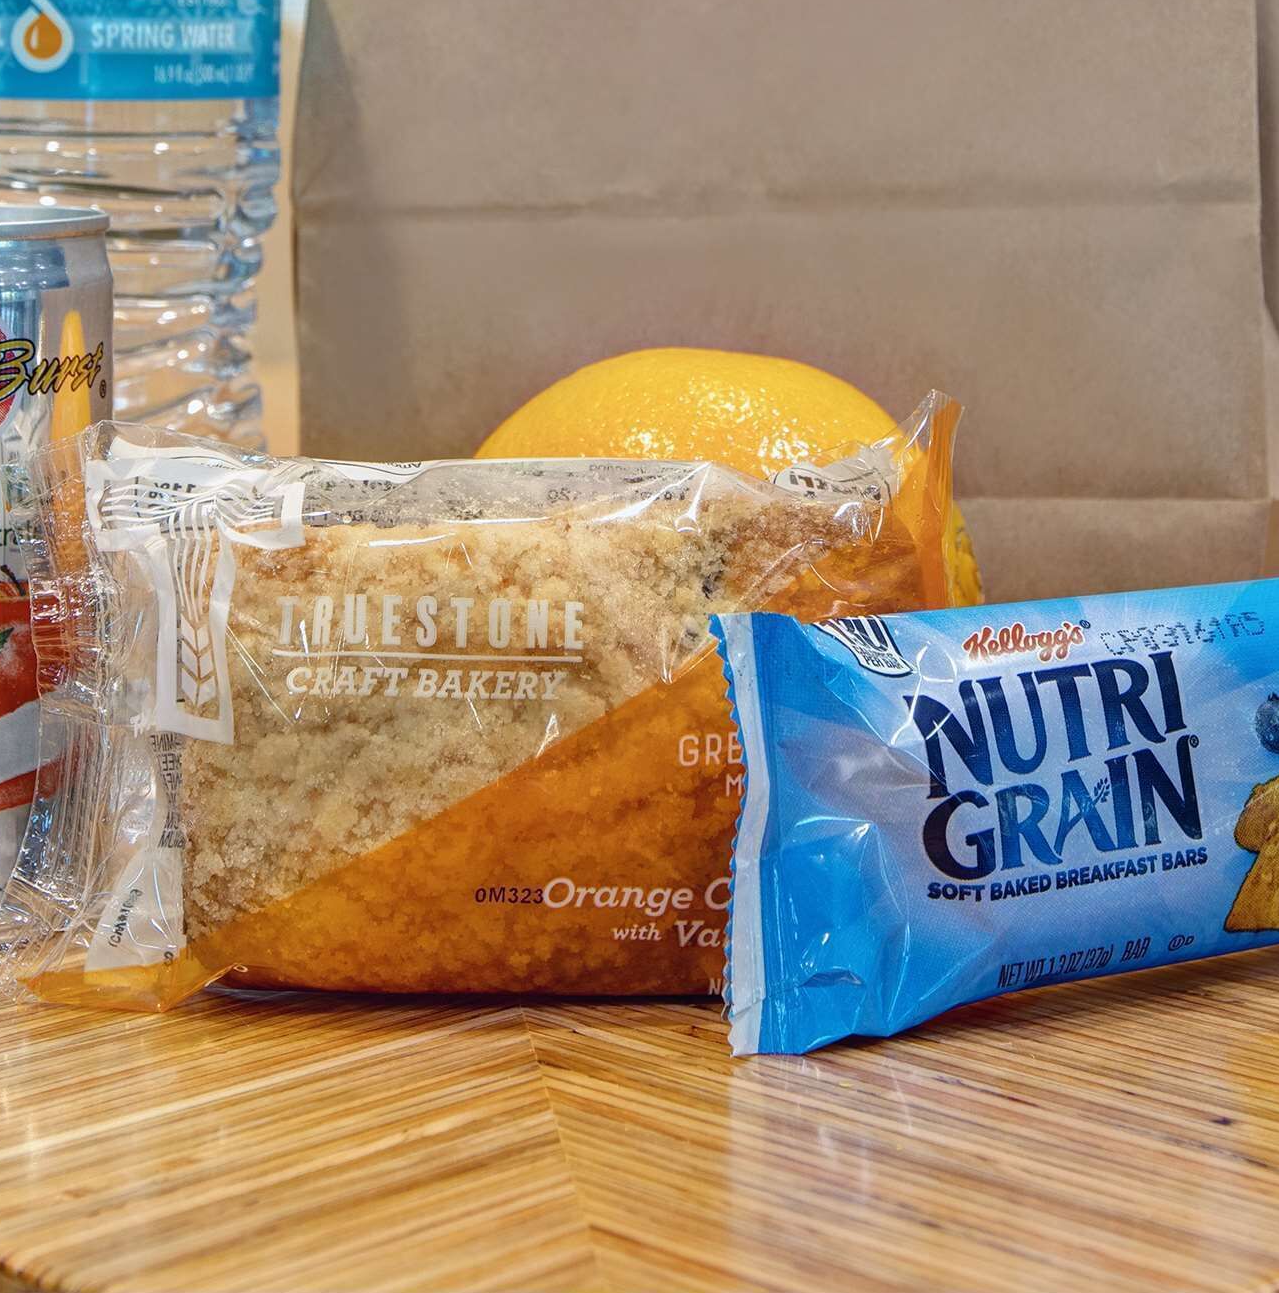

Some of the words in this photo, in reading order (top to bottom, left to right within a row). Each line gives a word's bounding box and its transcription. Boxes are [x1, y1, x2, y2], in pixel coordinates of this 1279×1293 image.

[91, 20, 175, 50] SPRING
[180, 23, 237, 50] WATER
[276, 594, 585, 650] TRUESTONE
[963, 622, 1084, 662] Kellogg's
[286, 666, 409, 698] CRAFT
[413, 668, 570, 701] BAKERY
[902, 651, 1189, 800] NUTRI
[922, 735, 1204, 882] GRAIN
[927, 881, 986, 902] SOFT
[990, 874, 1053, 902] BAKED
[1056, 855, 1159, 890] BREAKFAST
[1161, 846, 1209, 873] BARS
[543, 876, 695, 918] Orange
[611, 921, 663, 942] with
[997, 961, 1025, 989] NET
